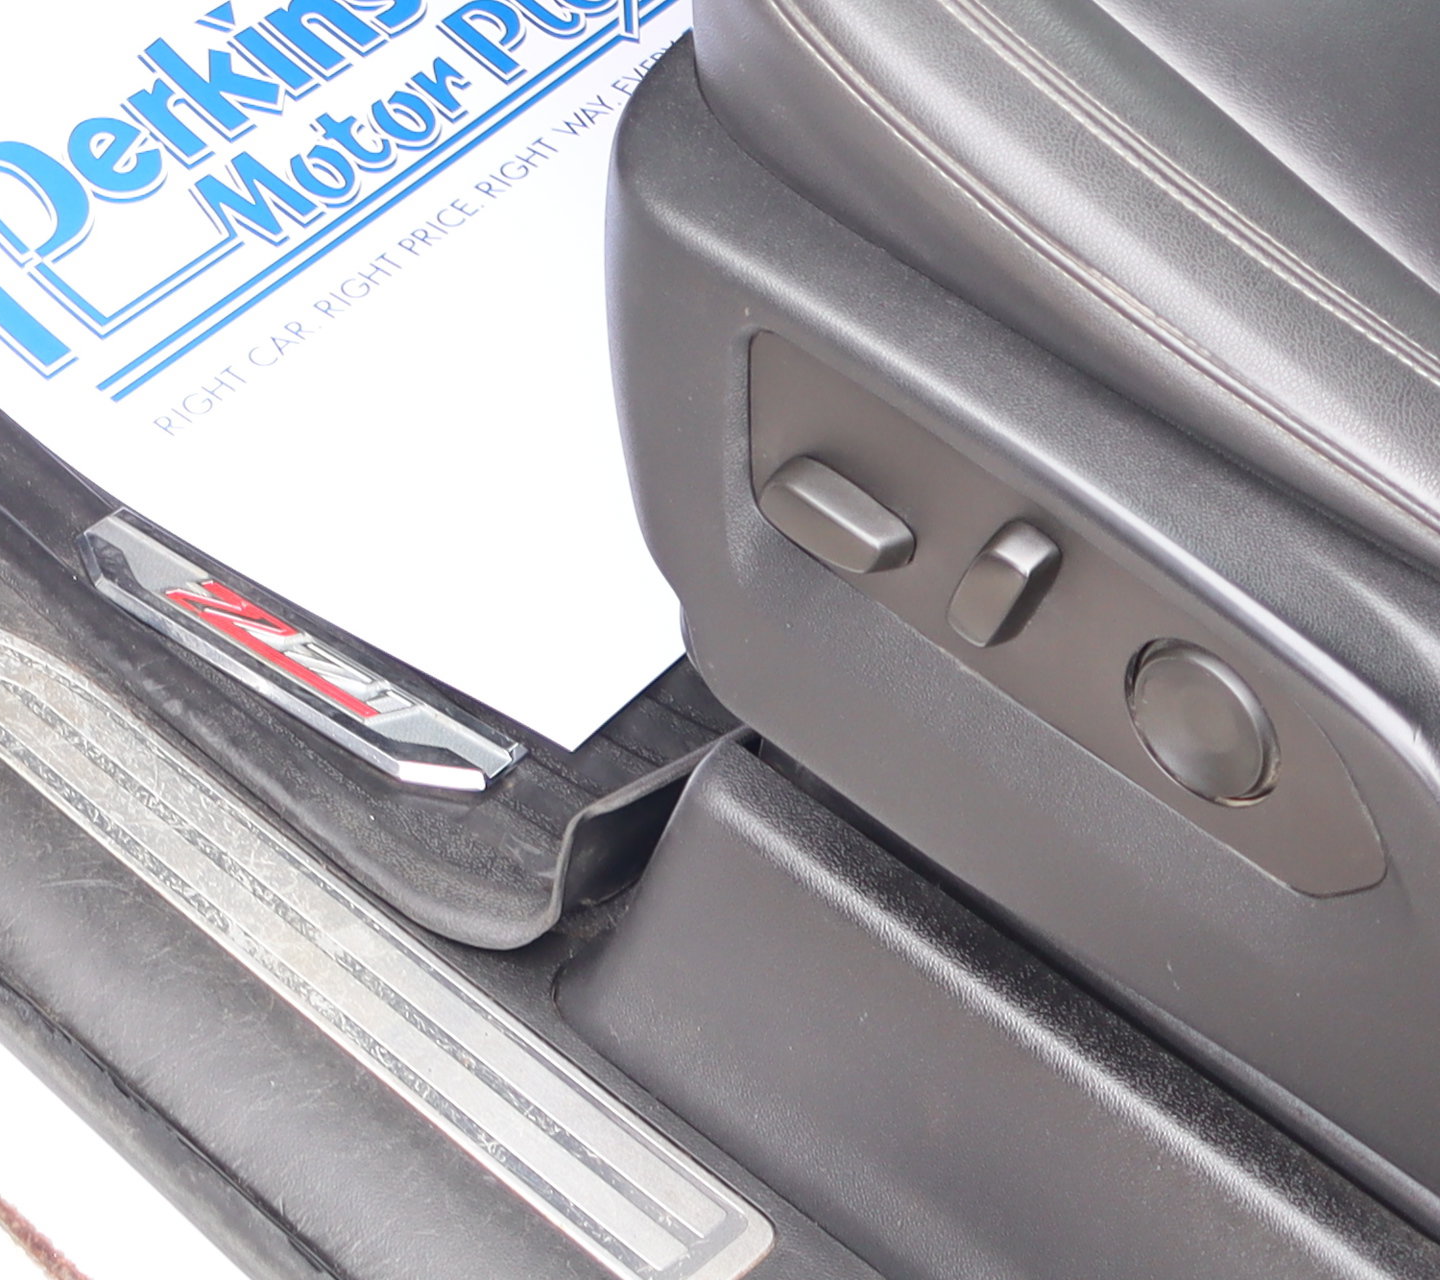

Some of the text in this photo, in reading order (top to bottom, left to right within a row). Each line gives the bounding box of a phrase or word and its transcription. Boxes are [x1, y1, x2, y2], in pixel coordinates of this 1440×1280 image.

[152, 365, 248, 438] RIGHT
[246, 320, 323, 368] CAR.
[313, 252, 403, 320] RIGHT
[397, 198, 486, 257] PRICE.
[473, 136, 560, 201] RIGHT
[551, 94, 622, 137] WAY.
[188, 56, 472, 248] Motor
